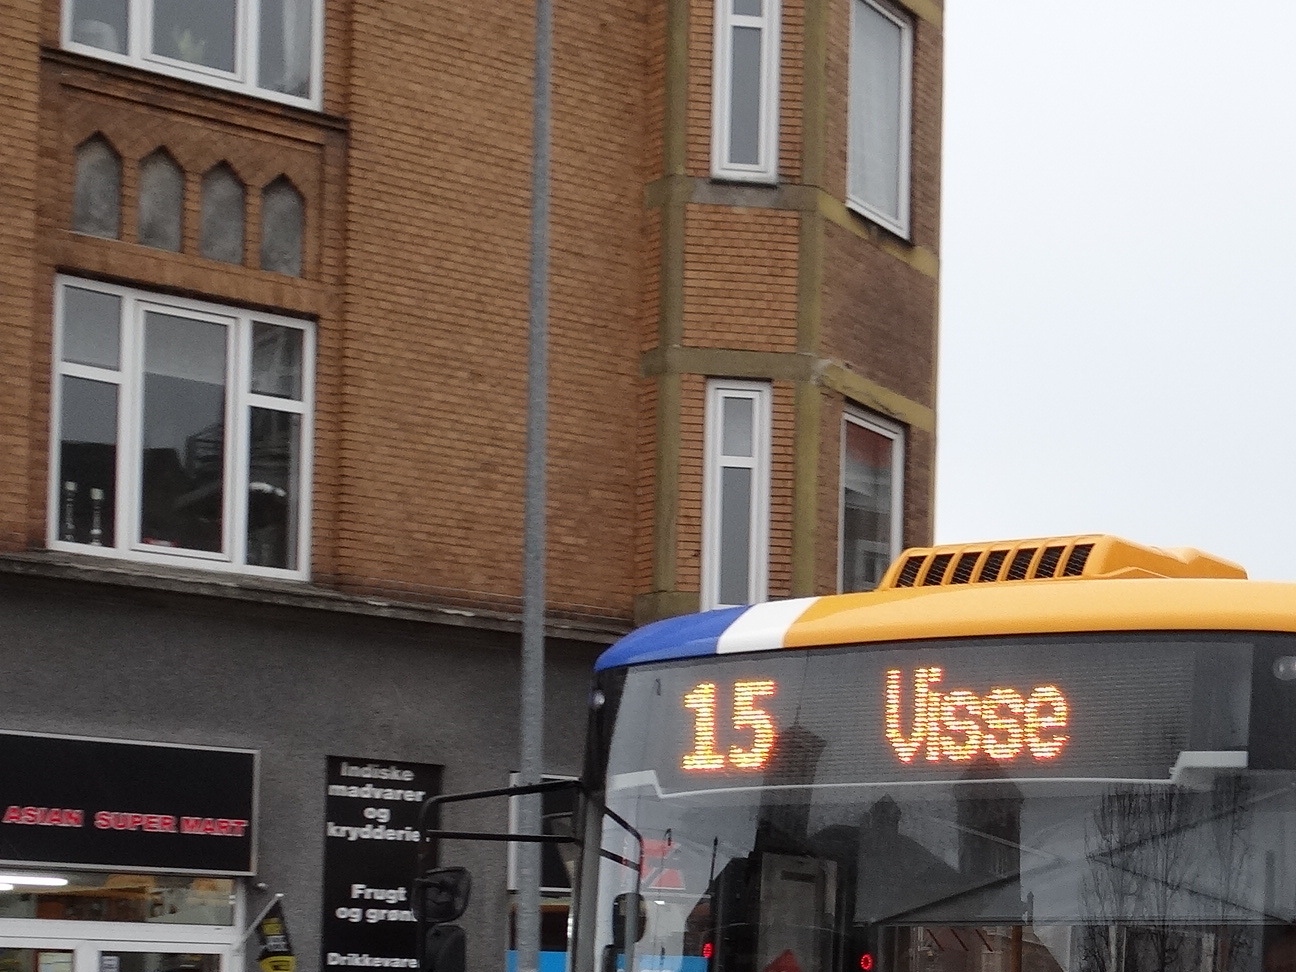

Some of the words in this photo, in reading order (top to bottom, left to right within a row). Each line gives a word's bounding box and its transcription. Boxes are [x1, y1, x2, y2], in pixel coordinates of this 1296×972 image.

[681, 681, 775, 771] 15
[886, 667, 1069, 763] Visse
[341, 761, 415, 781] Indiske
[2, 805, 84, 828] ASIAN
[94, 810, 179, 834] SUPER
[180, 816, 249, 837] MART
[363, 809, 391, 823] og
[326, 822, 430, 842] krydderie
[351, 883, 408, 904] Frugt
[335, 907, 363, 923] og
[327, 952, 420, 969] Drikkevare
